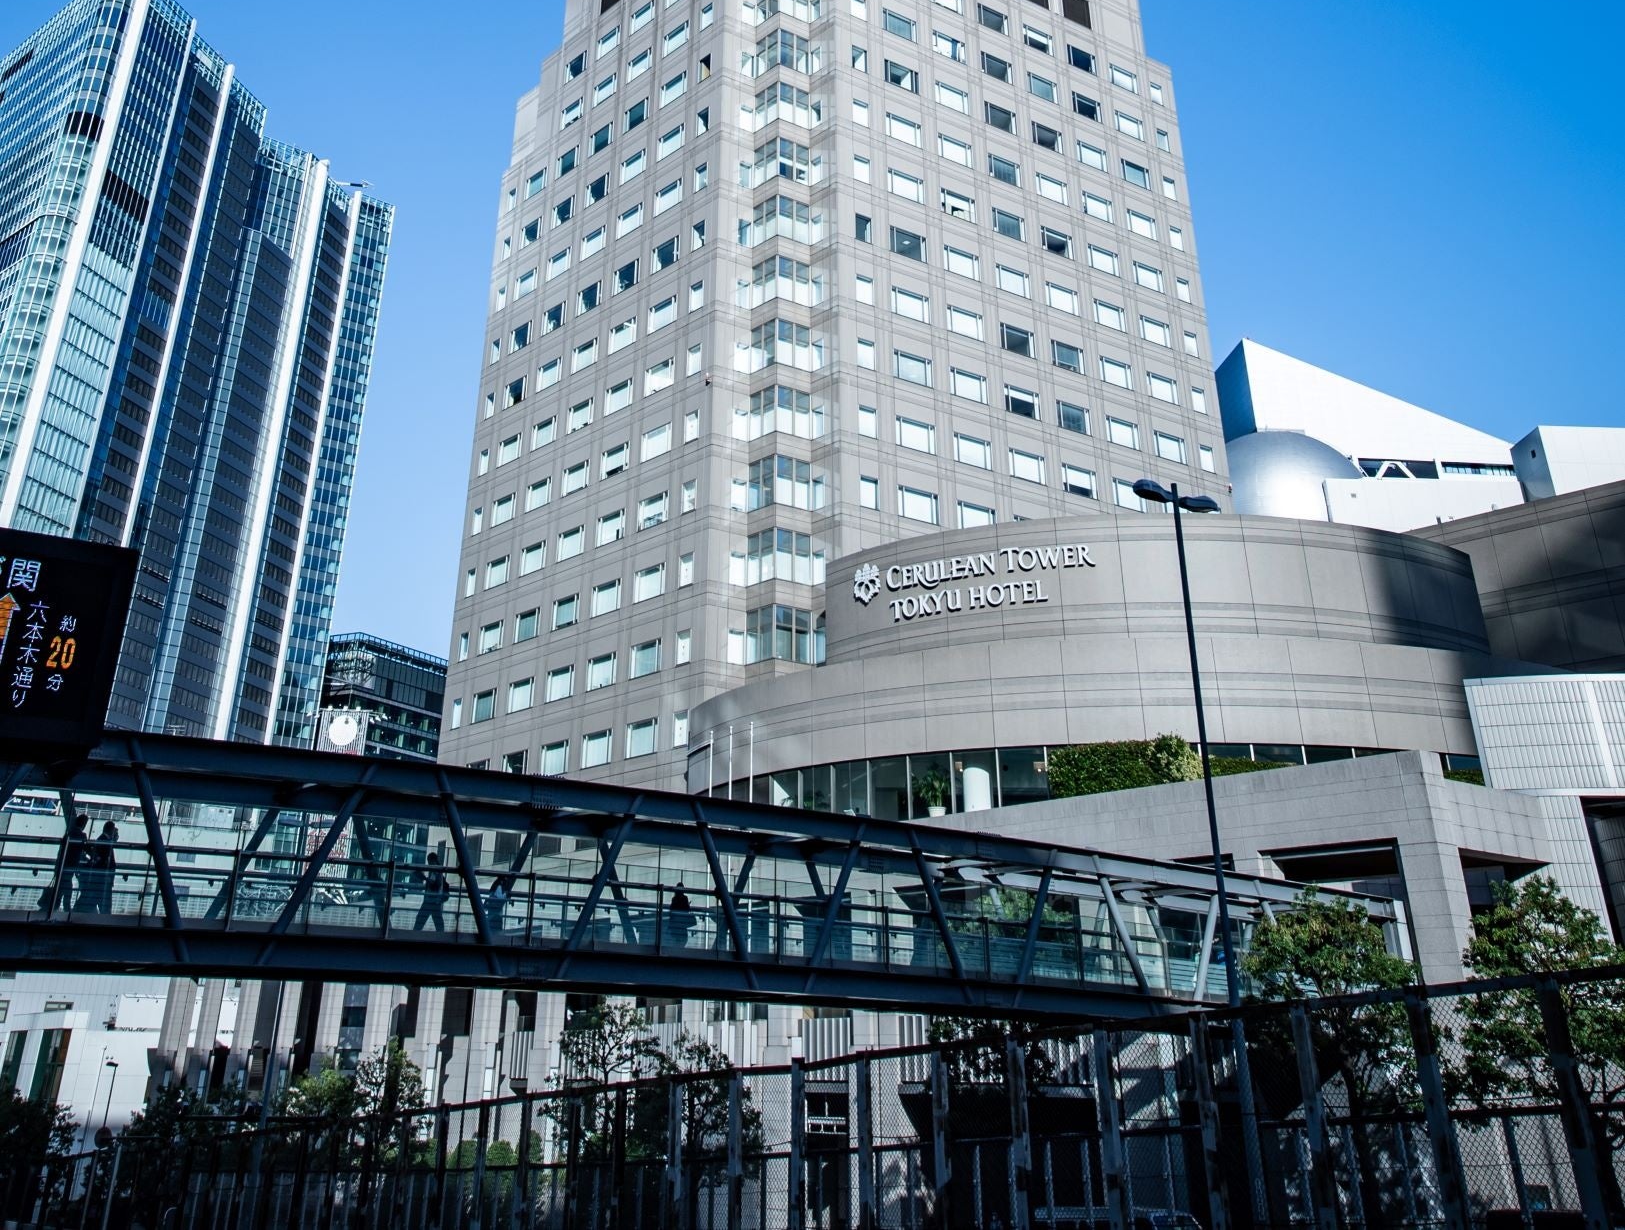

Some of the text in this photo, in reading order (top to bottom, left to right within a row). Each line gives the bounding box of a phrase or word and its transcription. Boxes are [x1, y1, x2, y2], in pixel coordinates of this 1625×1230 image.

[0, 556, 41, 592] 関
[886, 544, 1096, 590] CERULEAN TOWER
[889, 579, 1049, 622] TOKYU HOTEL
[11, 601, 50, 708] 六本木通り
